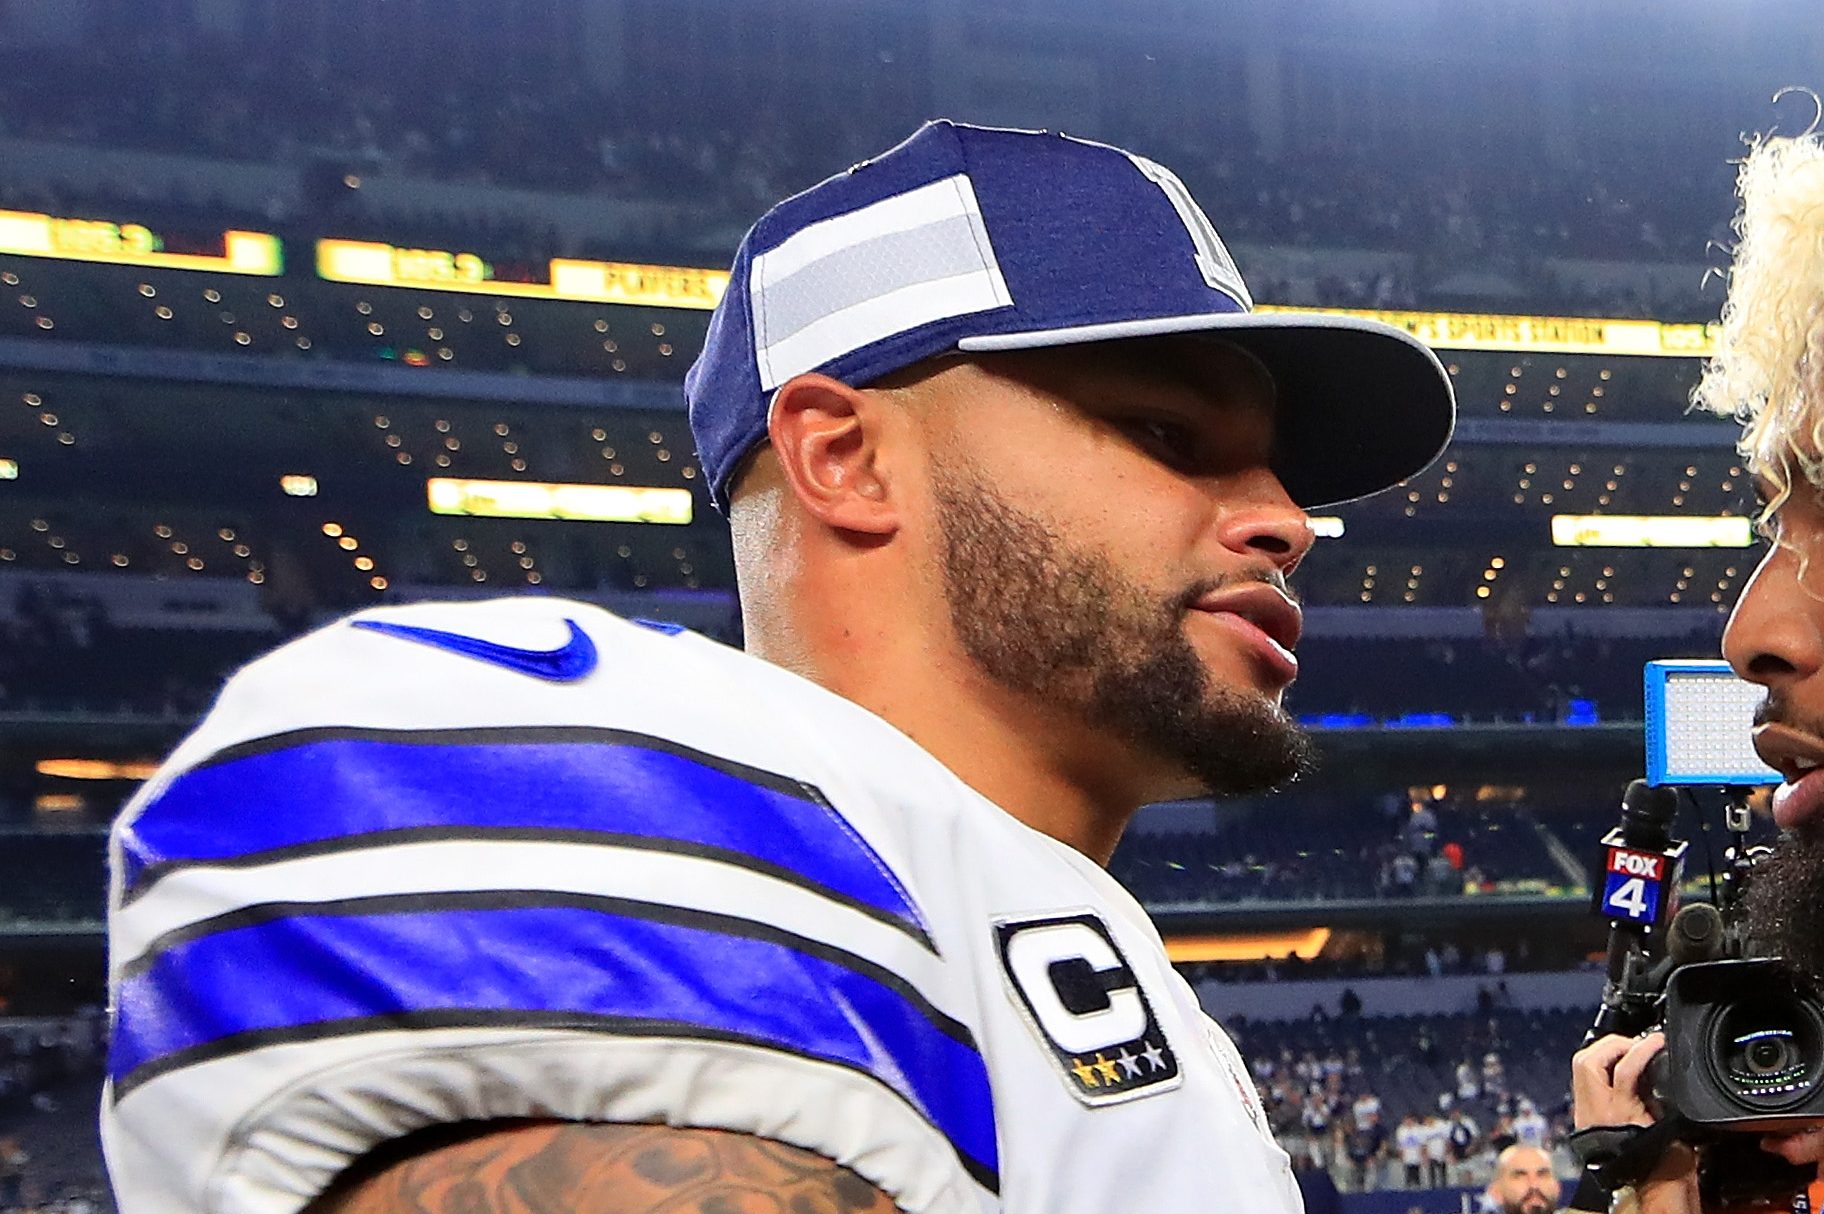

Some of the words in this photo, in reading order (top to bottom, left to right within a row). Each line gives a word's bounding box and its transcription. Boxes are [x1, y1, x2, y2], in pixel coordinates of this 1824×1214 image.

[1613, 851, 1658, 878] FOX
[1609, 878, 1647, 918] 4
[1007, 923, 1148, 1054] C
